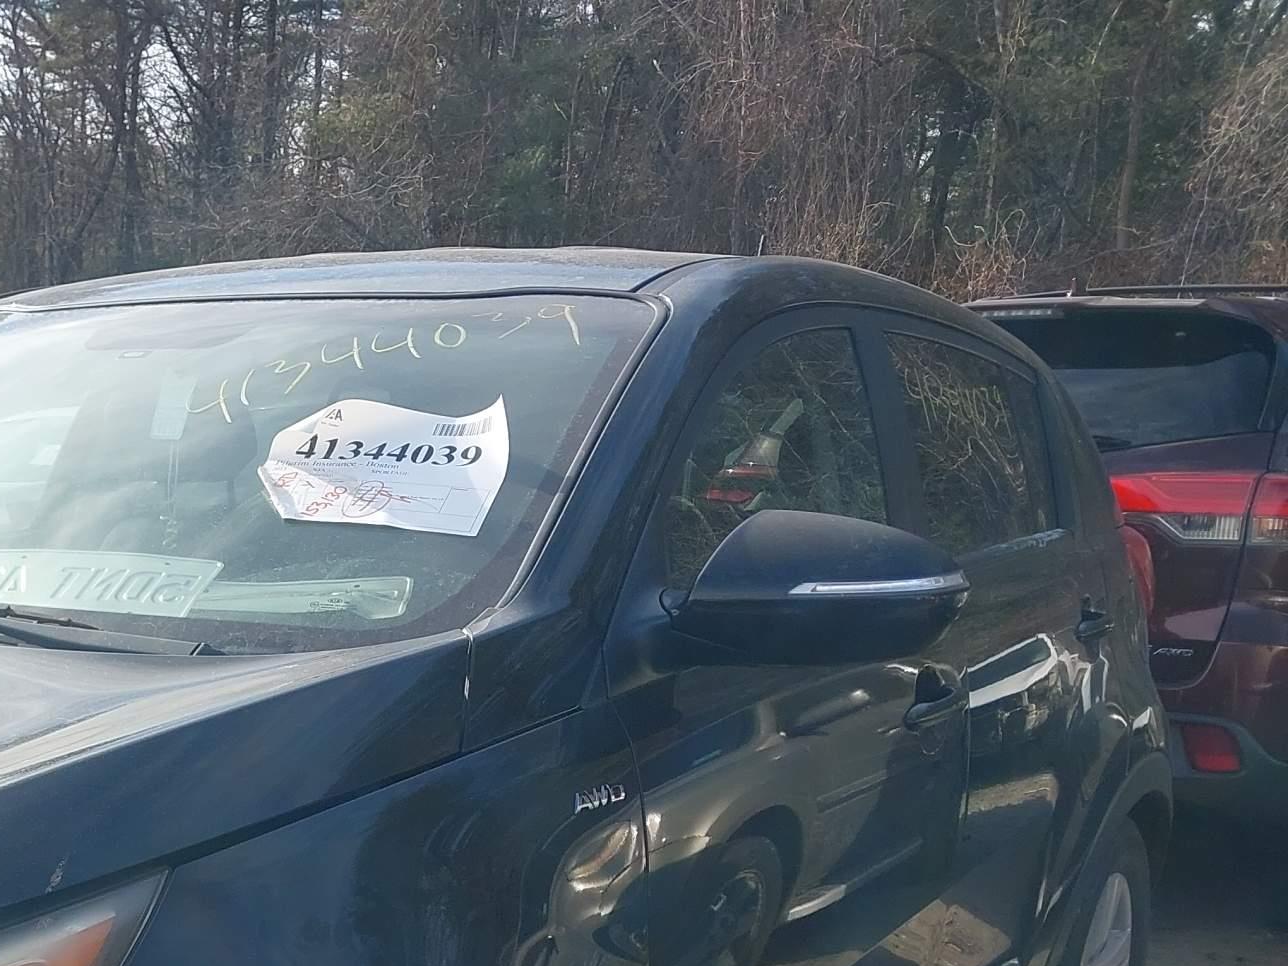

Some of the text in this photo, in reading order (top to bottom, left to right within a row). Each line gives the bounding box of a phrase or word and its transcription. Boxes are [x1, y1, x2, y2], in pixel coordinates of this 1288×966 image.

[295, 433, 483, 467] 41344039
[312, 460, 357, 468] Insurance
[574, 784, 626, 814] AWD
